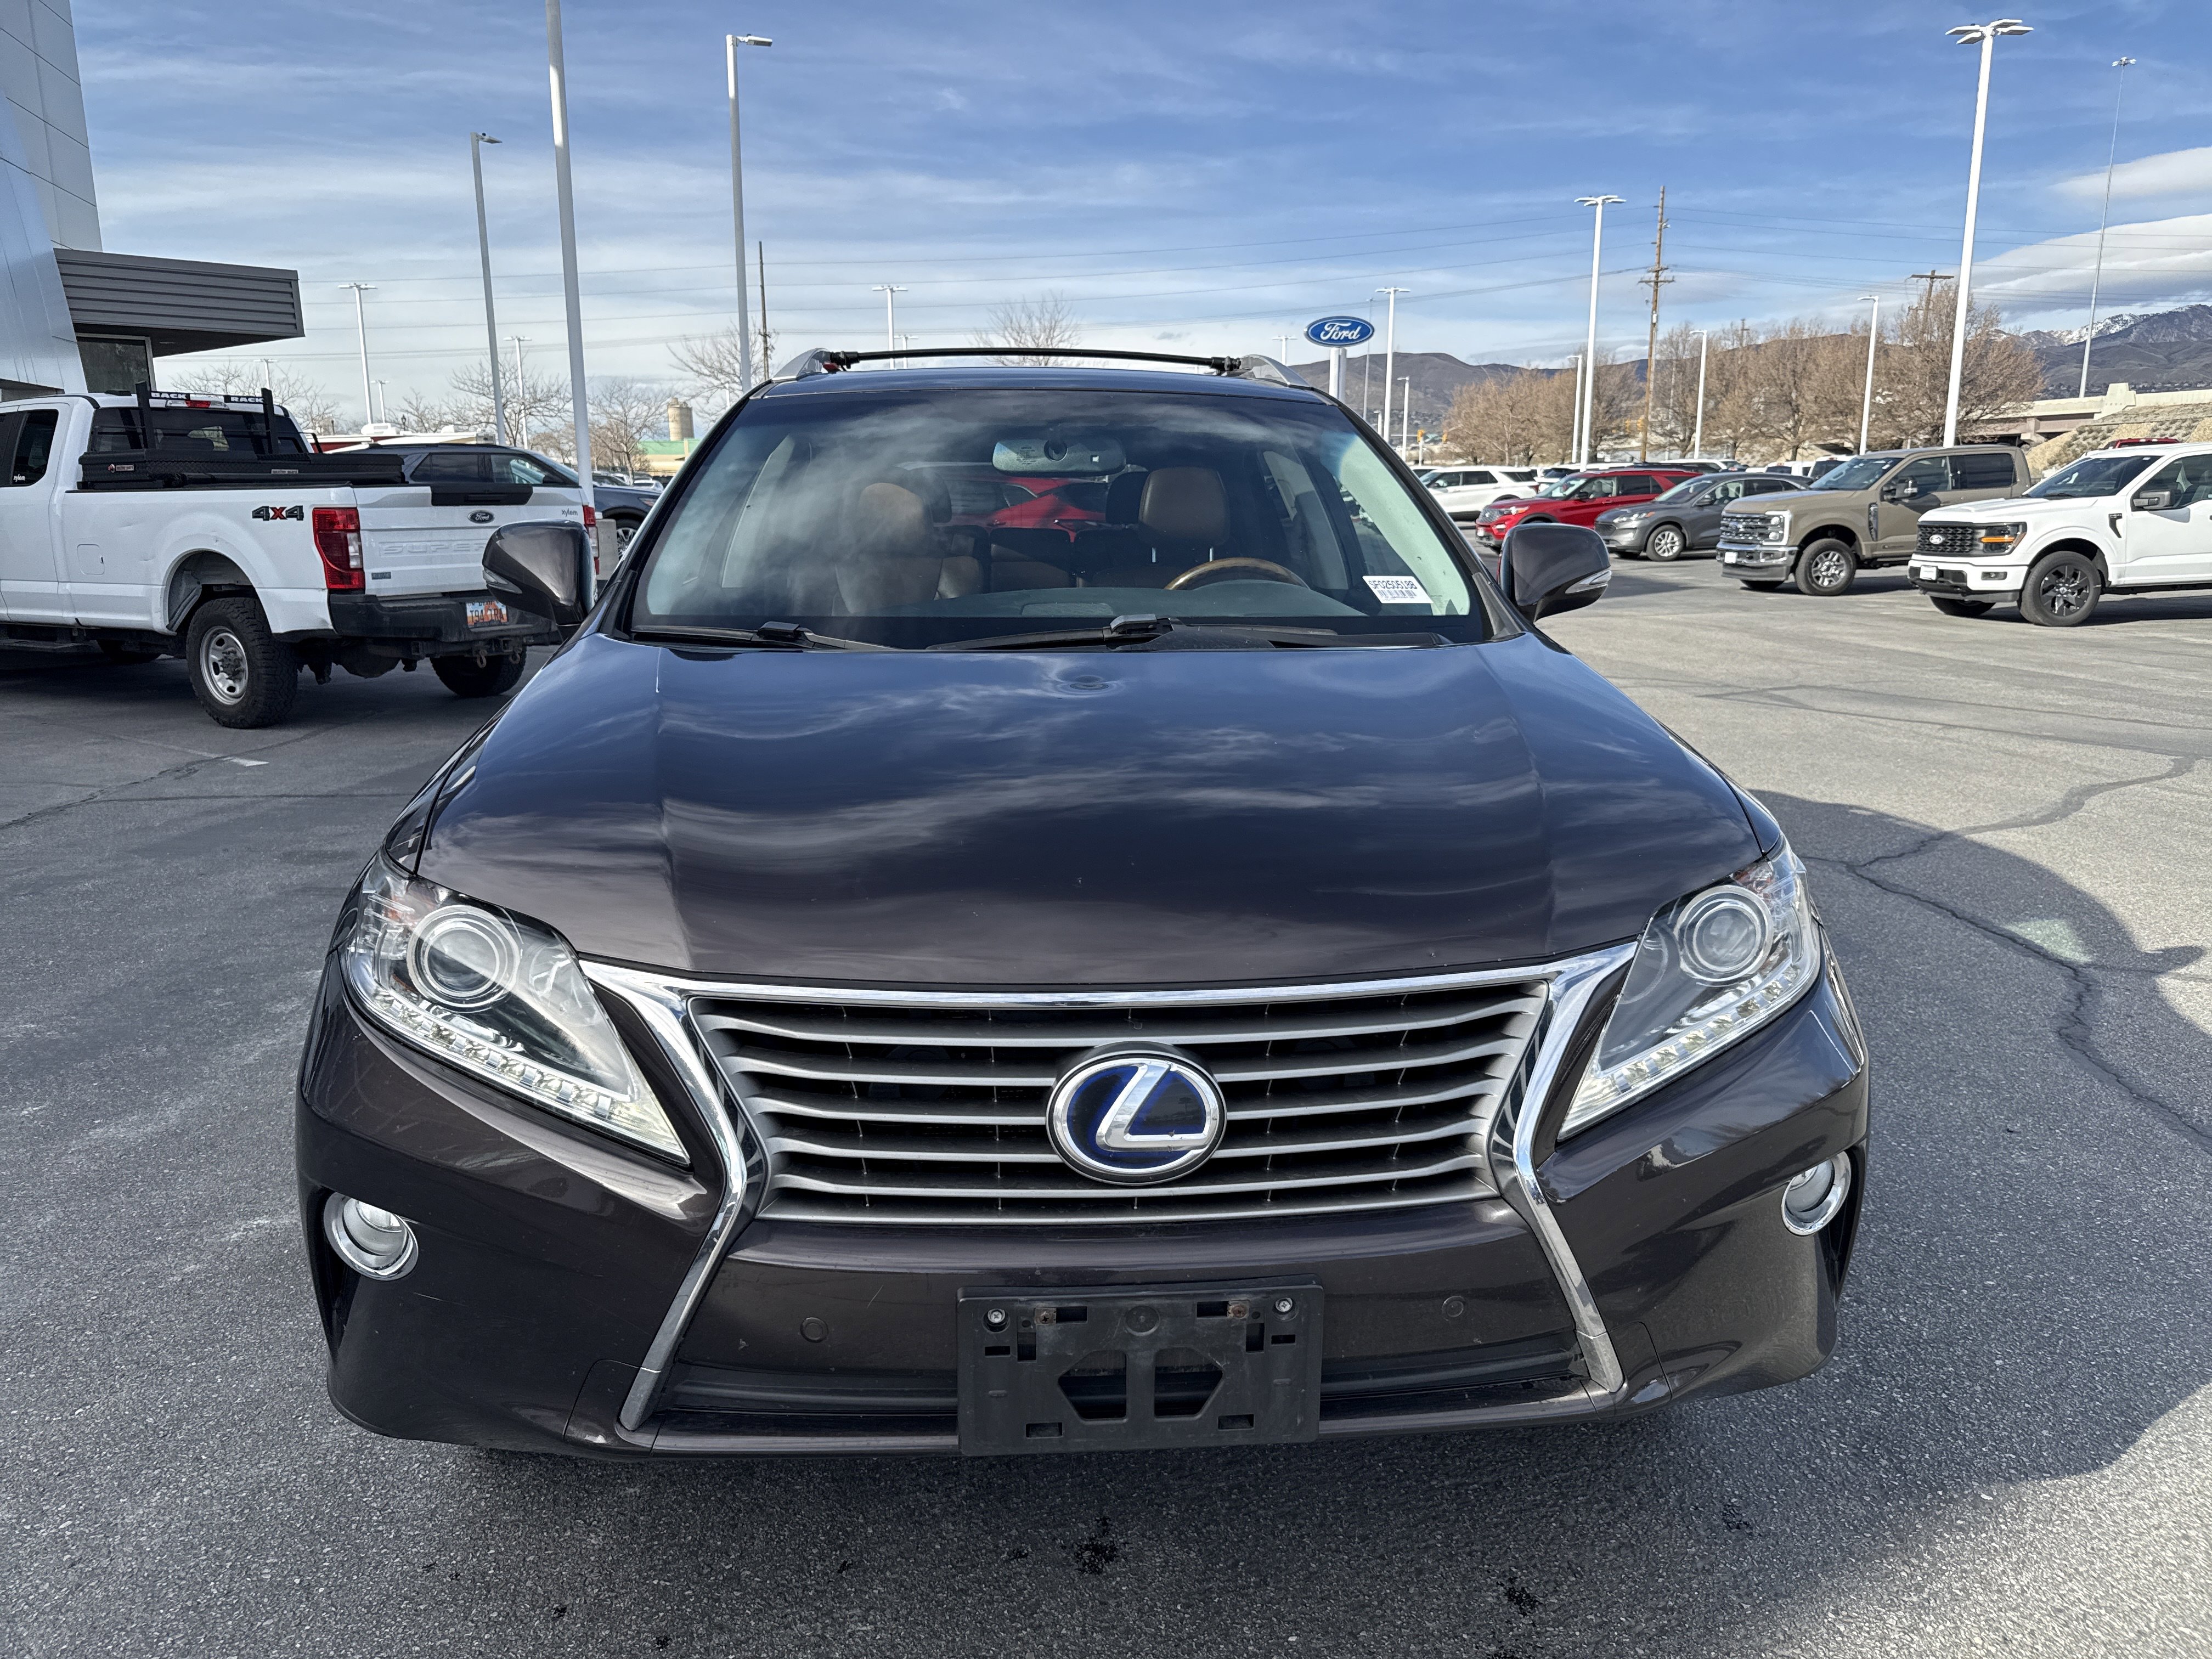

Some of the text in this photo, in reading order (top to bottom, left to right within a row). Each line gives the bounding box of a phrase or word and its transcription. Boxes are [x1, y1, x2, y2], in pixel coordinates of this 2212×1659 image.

[1320, 321, 1362, 340] Ford
[151, 392, 187, 400] BACK
[475, 512, 490, 521] Ford
[561, 508, 578, 517] xylem
